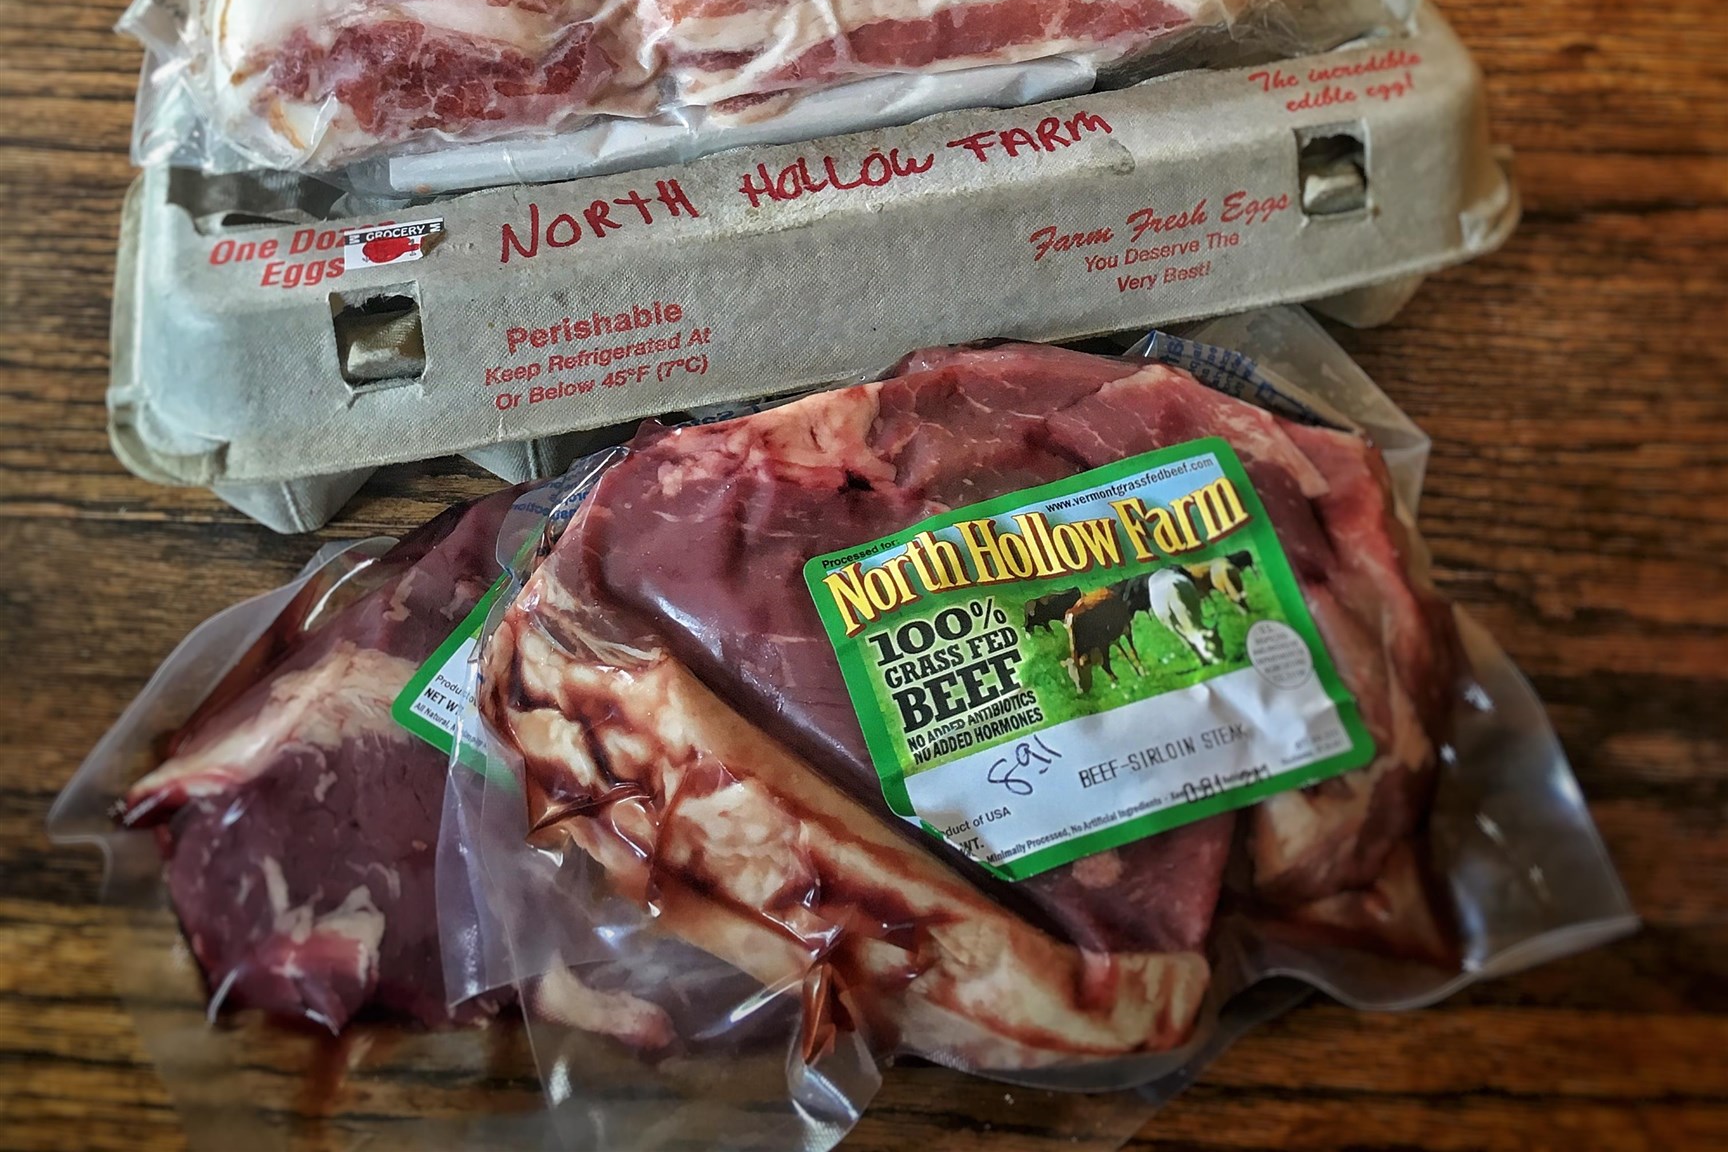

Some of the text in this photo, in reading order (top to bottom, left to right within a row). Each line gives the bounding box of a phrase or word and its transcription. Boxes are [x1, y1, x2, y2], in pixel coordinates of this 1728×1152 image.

[1248, 49, 1422, 93] The incredible
[1286, 70, 1415, 112] edible egg!
[499, 110, 1114, 264] NORTH HOLLOW FARM
[366, 224, 426, 242] GROCERY
[1028, 190, 1290, 262] Farm Fresh Eggs
[209, 238, 280, 266] One
[260, 257, 345, 289] Eggs
[1084, 231, 1240, 273] You Deserve The
[1116, 260, 1212, 293] Very Best!
[506, 300, 684, 355] Perishable
[485, 327, 711, 387] Keep Refrigerated At
[495, 392, 522, 411] Or
[529, 379, 595, 405] Below
[1045, 457, 1215, 513] www.vermontgrassfedbeef.com
[822, 538, 900, 569] Processed for:
[823, 476, 1252, 637] North Hollow Farm
[869, 597, 1007, 666] 100%
[884, 626, 1019, 688] GRASS FED
[414, 702, 452, 730] All Natural,
[424, 688, 446, 706] NET
[892, 649, 1023, 733] BEEF
[907, 690, 1036, 752] NO ADDED ANTIBIOTICS
[914, 707, 1044, 765] NO ADDED HORMONES
[1078, 735, 1197, 788] BEEF-SIRLOIN
[943, 806, 1012, 837] duct of USA
[986, 843, 1026, 863] Minimally
[1026, 827, 1072, 849] Processed,
[1071, 823, 1083, 834] No
[1083, 812, 1118, 830] Artificial
